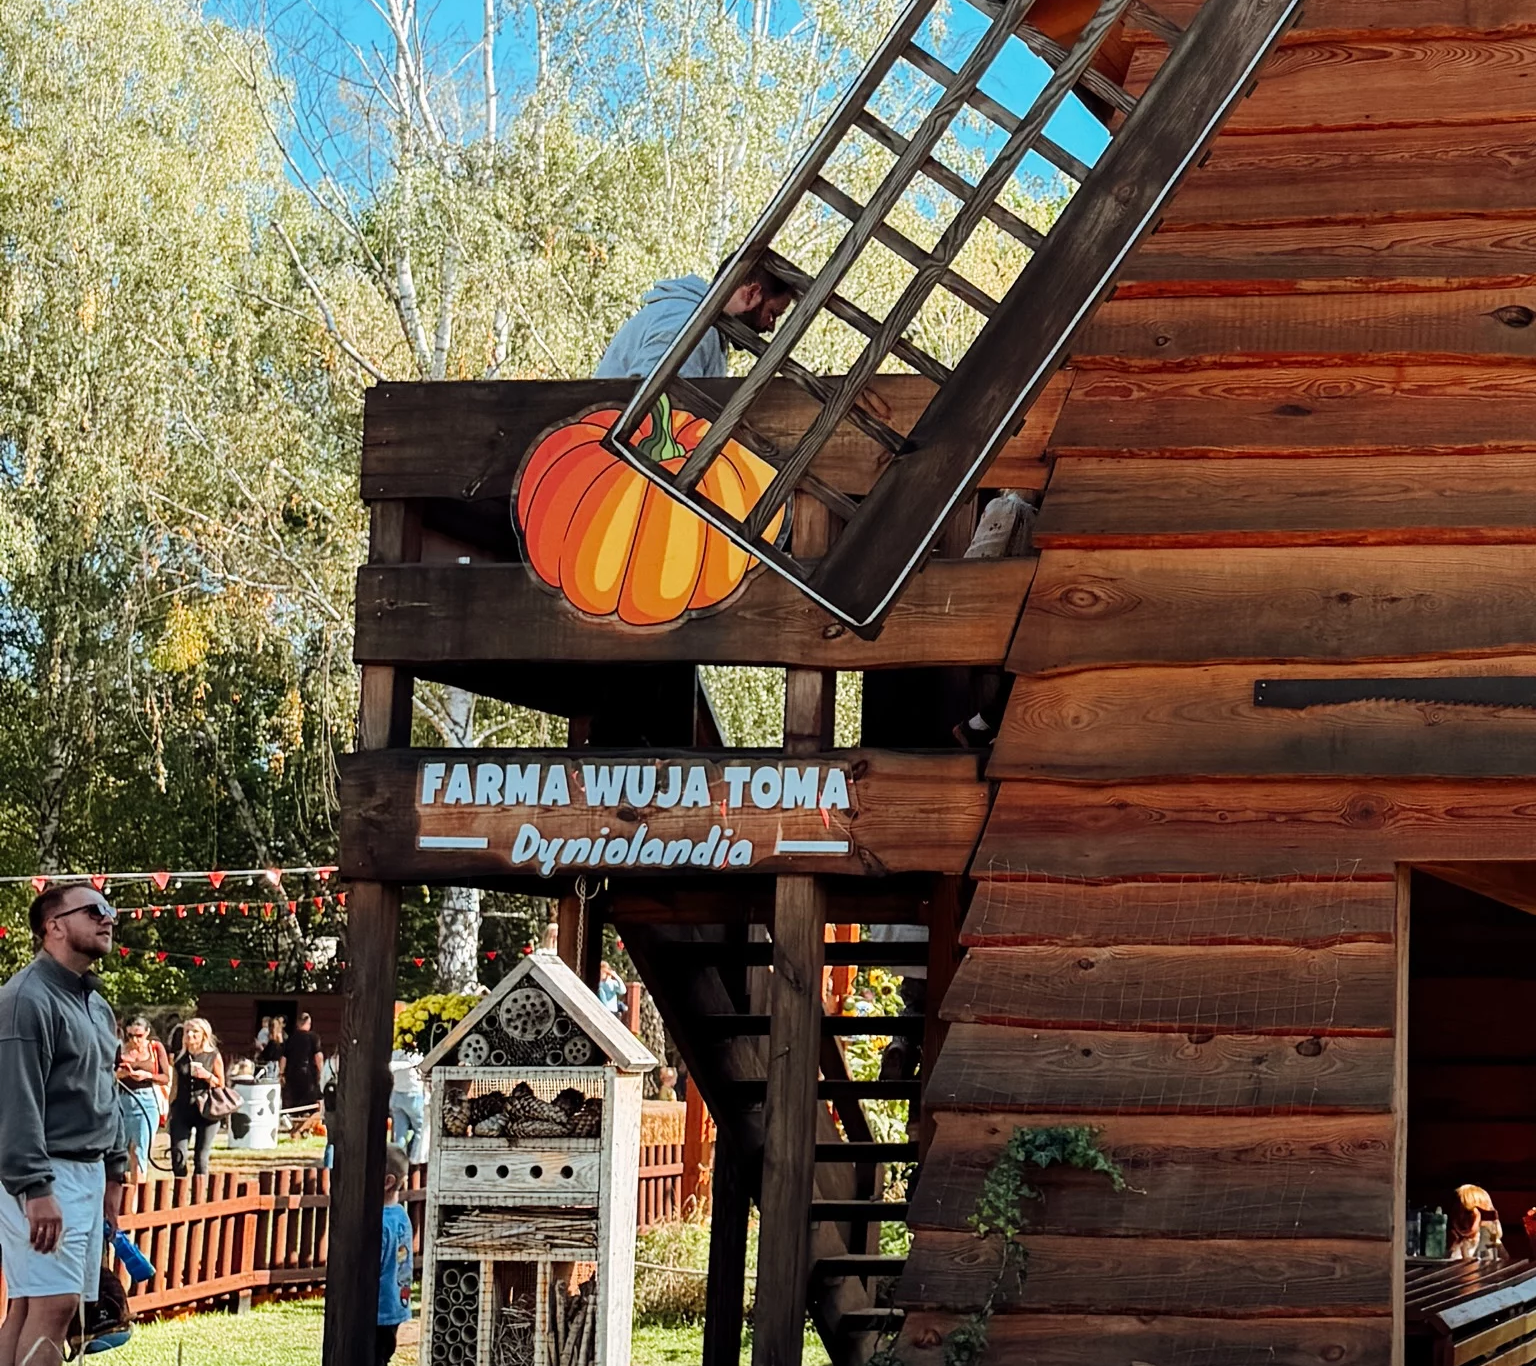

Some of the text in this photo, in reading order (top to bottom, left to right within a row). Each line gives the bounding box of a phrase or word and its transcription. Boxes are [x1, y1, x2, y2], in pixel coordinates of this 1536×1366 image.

[421, 761, 850, 810] FARMA WUJA TOMA
[511, 822, 753, 878] Dyniolandia
